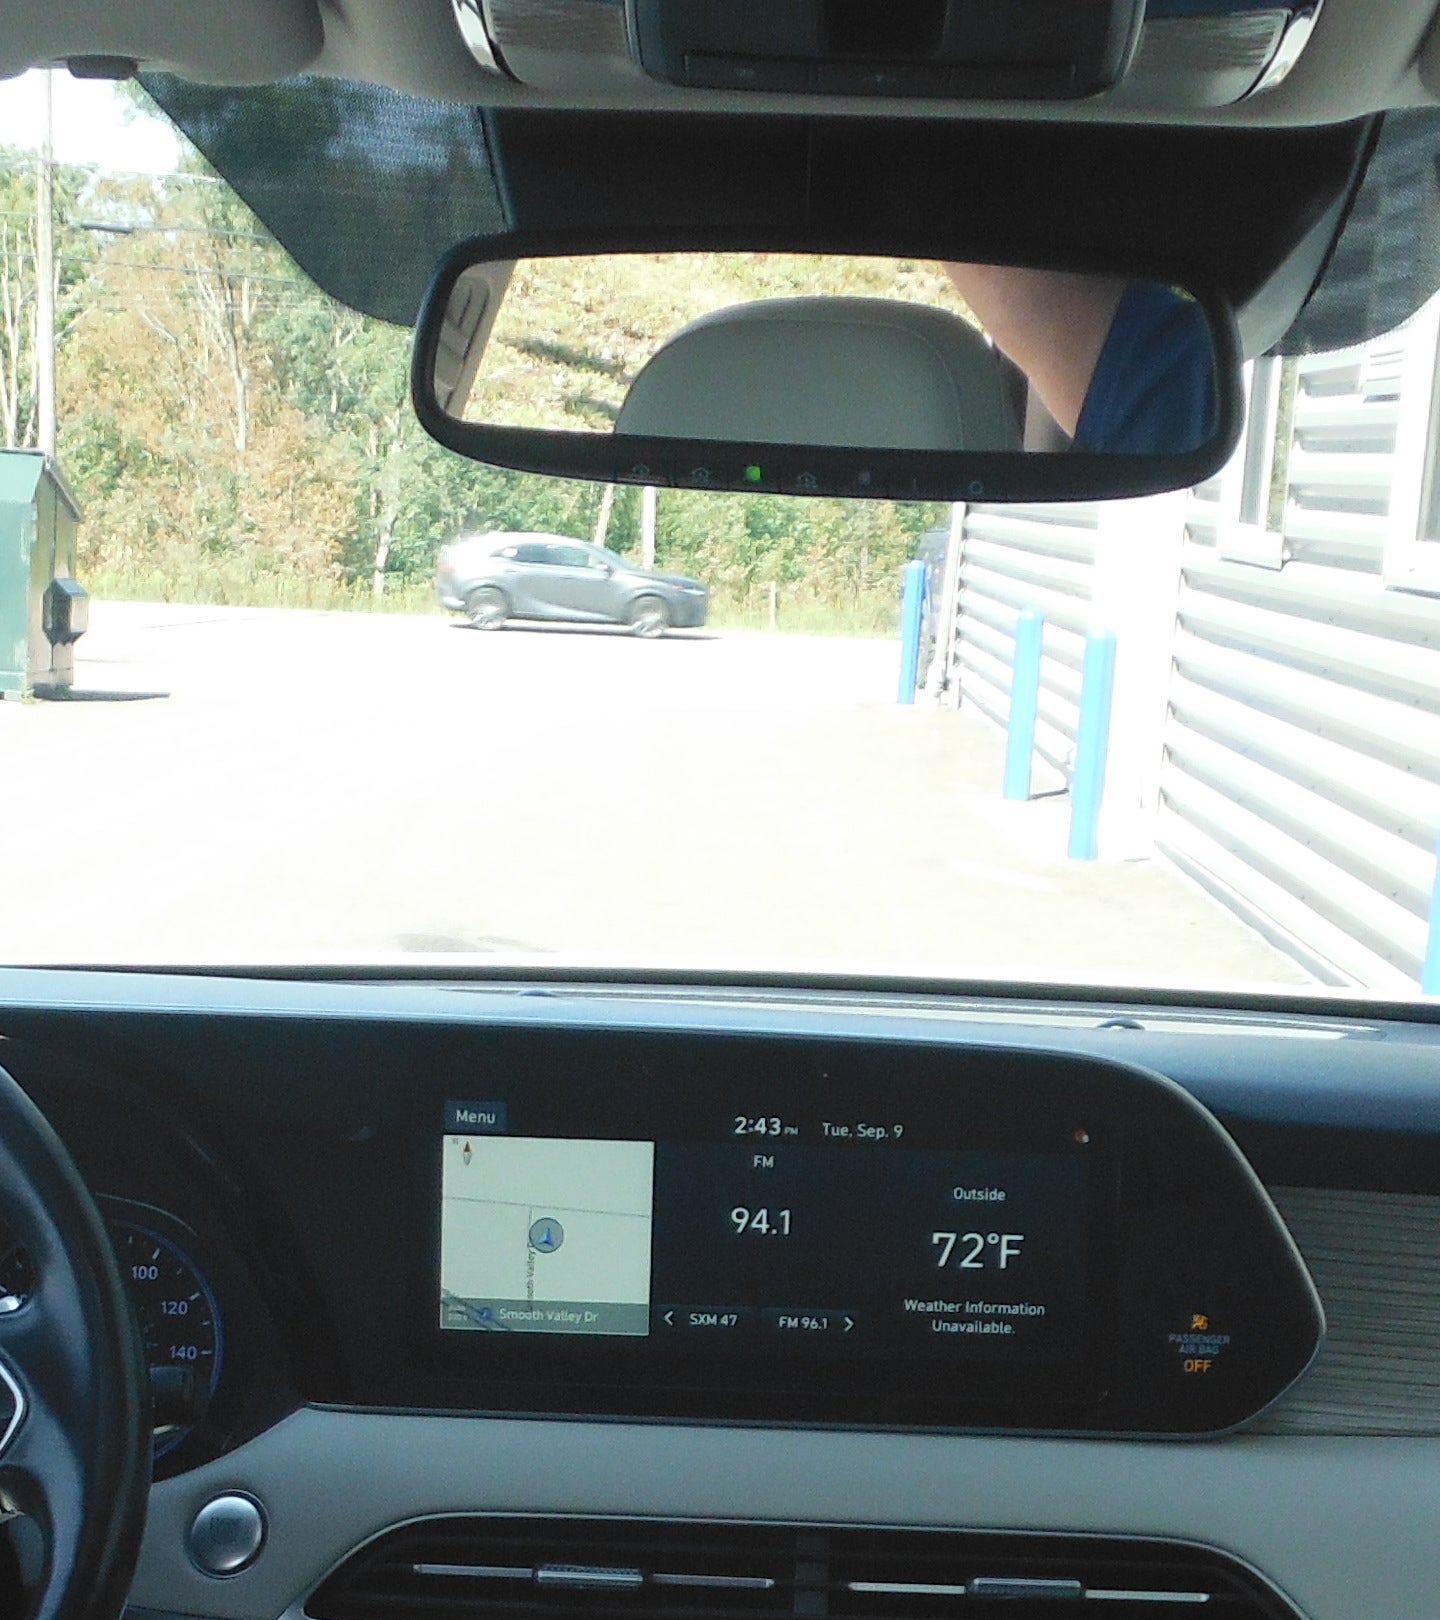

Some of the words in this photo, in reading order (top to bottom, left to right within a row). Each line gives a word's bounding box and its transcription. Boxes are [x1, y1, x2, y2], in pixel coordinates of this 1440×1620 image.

[456, 1109, 496, 1125] Menu
[734, 1116, 782, 1136] 2:43
[784, 1126, 799, 1136] PM
[822, 1121, 852, 1138] Tue.
[857, 1123, 888, 1140] Sep.
[893, 1124, 904, 1138] 9
[753, 1154, 774, 1168] FM
[952, 1186, 1006, 1201] Outside
[730, 1207, 791, 1235] 94.1
[931, 1232, 1025, 1269] 72°F
[131, 1265, 159, 1280] 100
[161, 1301, 188, 1315] 120
[904, 1299, 961, 1313] Weather
[965, 1301, 1046, 1316] Information
[499, 1307, 544, 1322] Smooth
[547, 1309, 582, 1324] Valley
[584, 1311, 599, 1323] Dr
[690, 1313, 718, 1327] SXM
[720, 1314, 738, 1327] 47
[779, 1316, 799, 1329] FM
[800, 1317, 828, 1330] 96.1
[932, 1320, 1016, 1334] Unavailable.
[1168, 1333, 1231, 1345] PASSENGER
[170, 1345, 197, 1360] 140
[1184, 1359, 1212, 1373] OFF
